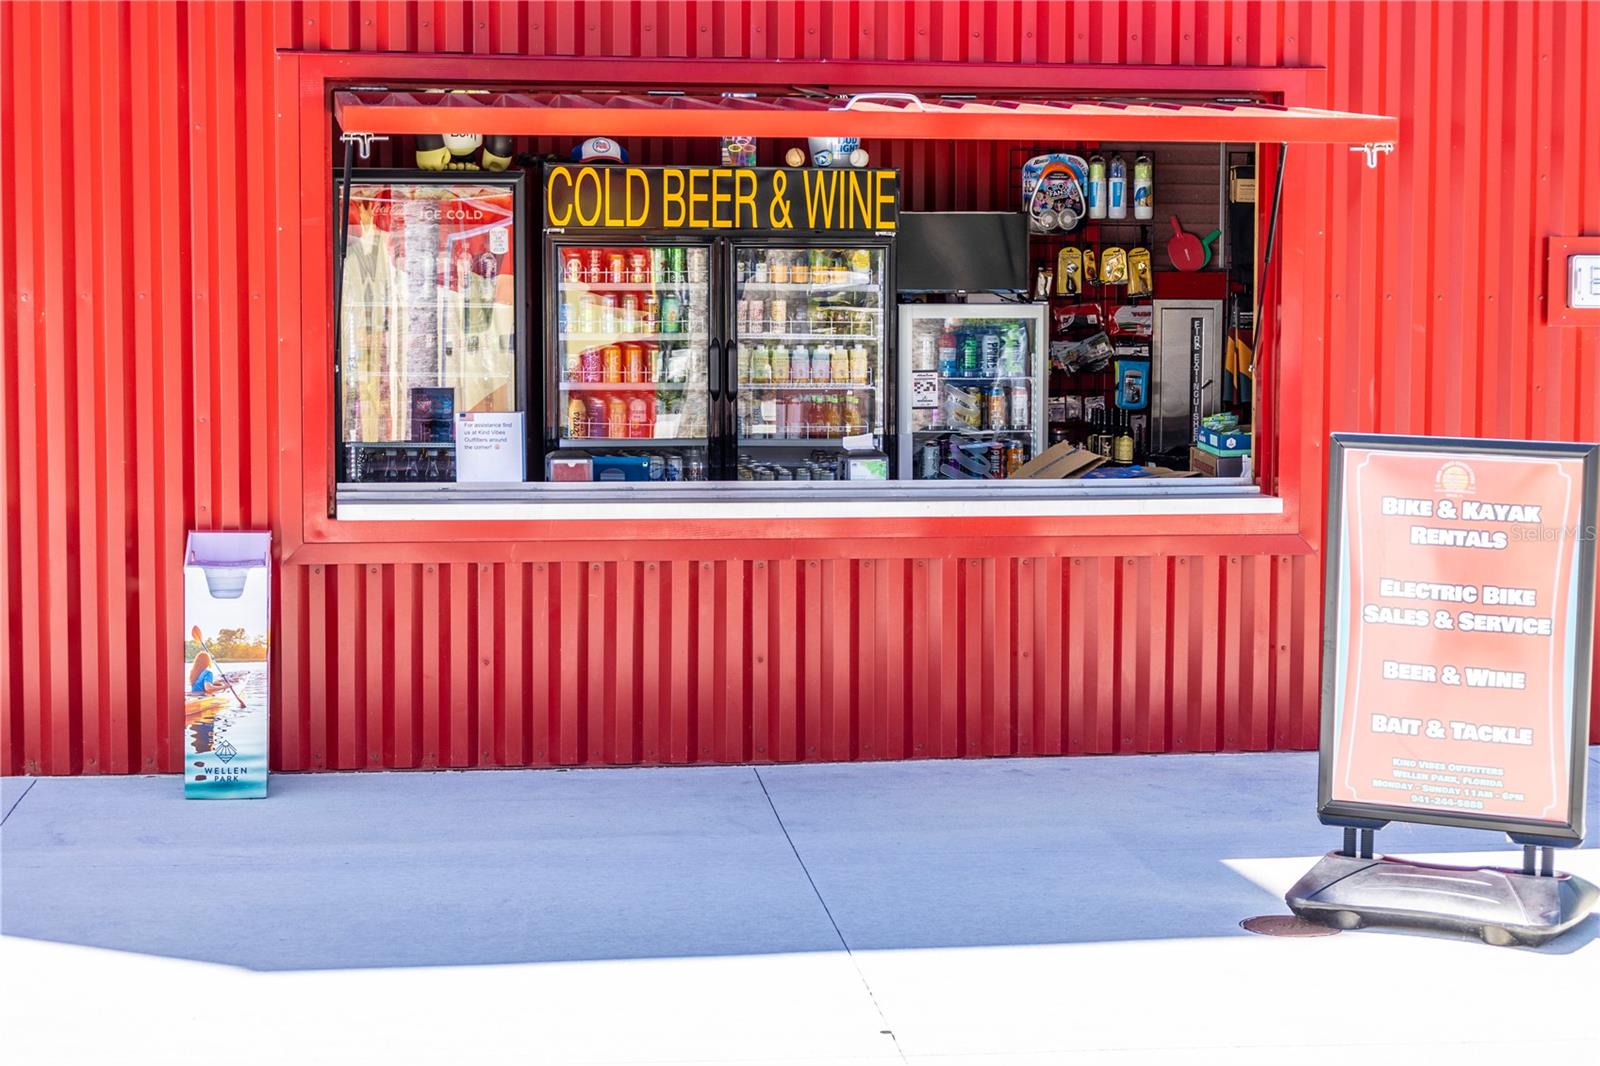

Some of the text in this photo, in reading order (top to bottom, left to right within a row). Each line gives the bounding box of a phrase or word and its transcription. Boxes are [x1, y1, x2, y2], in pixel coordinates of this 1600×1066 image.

[547, 166, 896, 230] COLD BEER & WINE
[446, 209, 484, 220] COLD
[1381, 496, 1541, 523] BIKE & KAYAK
[1410, 525, 1508, 549] RENTALS
[1379, 578, 1537, 607] ELECTRIC BIKE
[1362, 603, 1552, 636] SALES & SERVICE
[1383, 660, 1526, 690] BEER & WINE
[1371, 713, 1534, 746] BAIT & TACKLE
[204, 767, 248, 775] WELLEN
